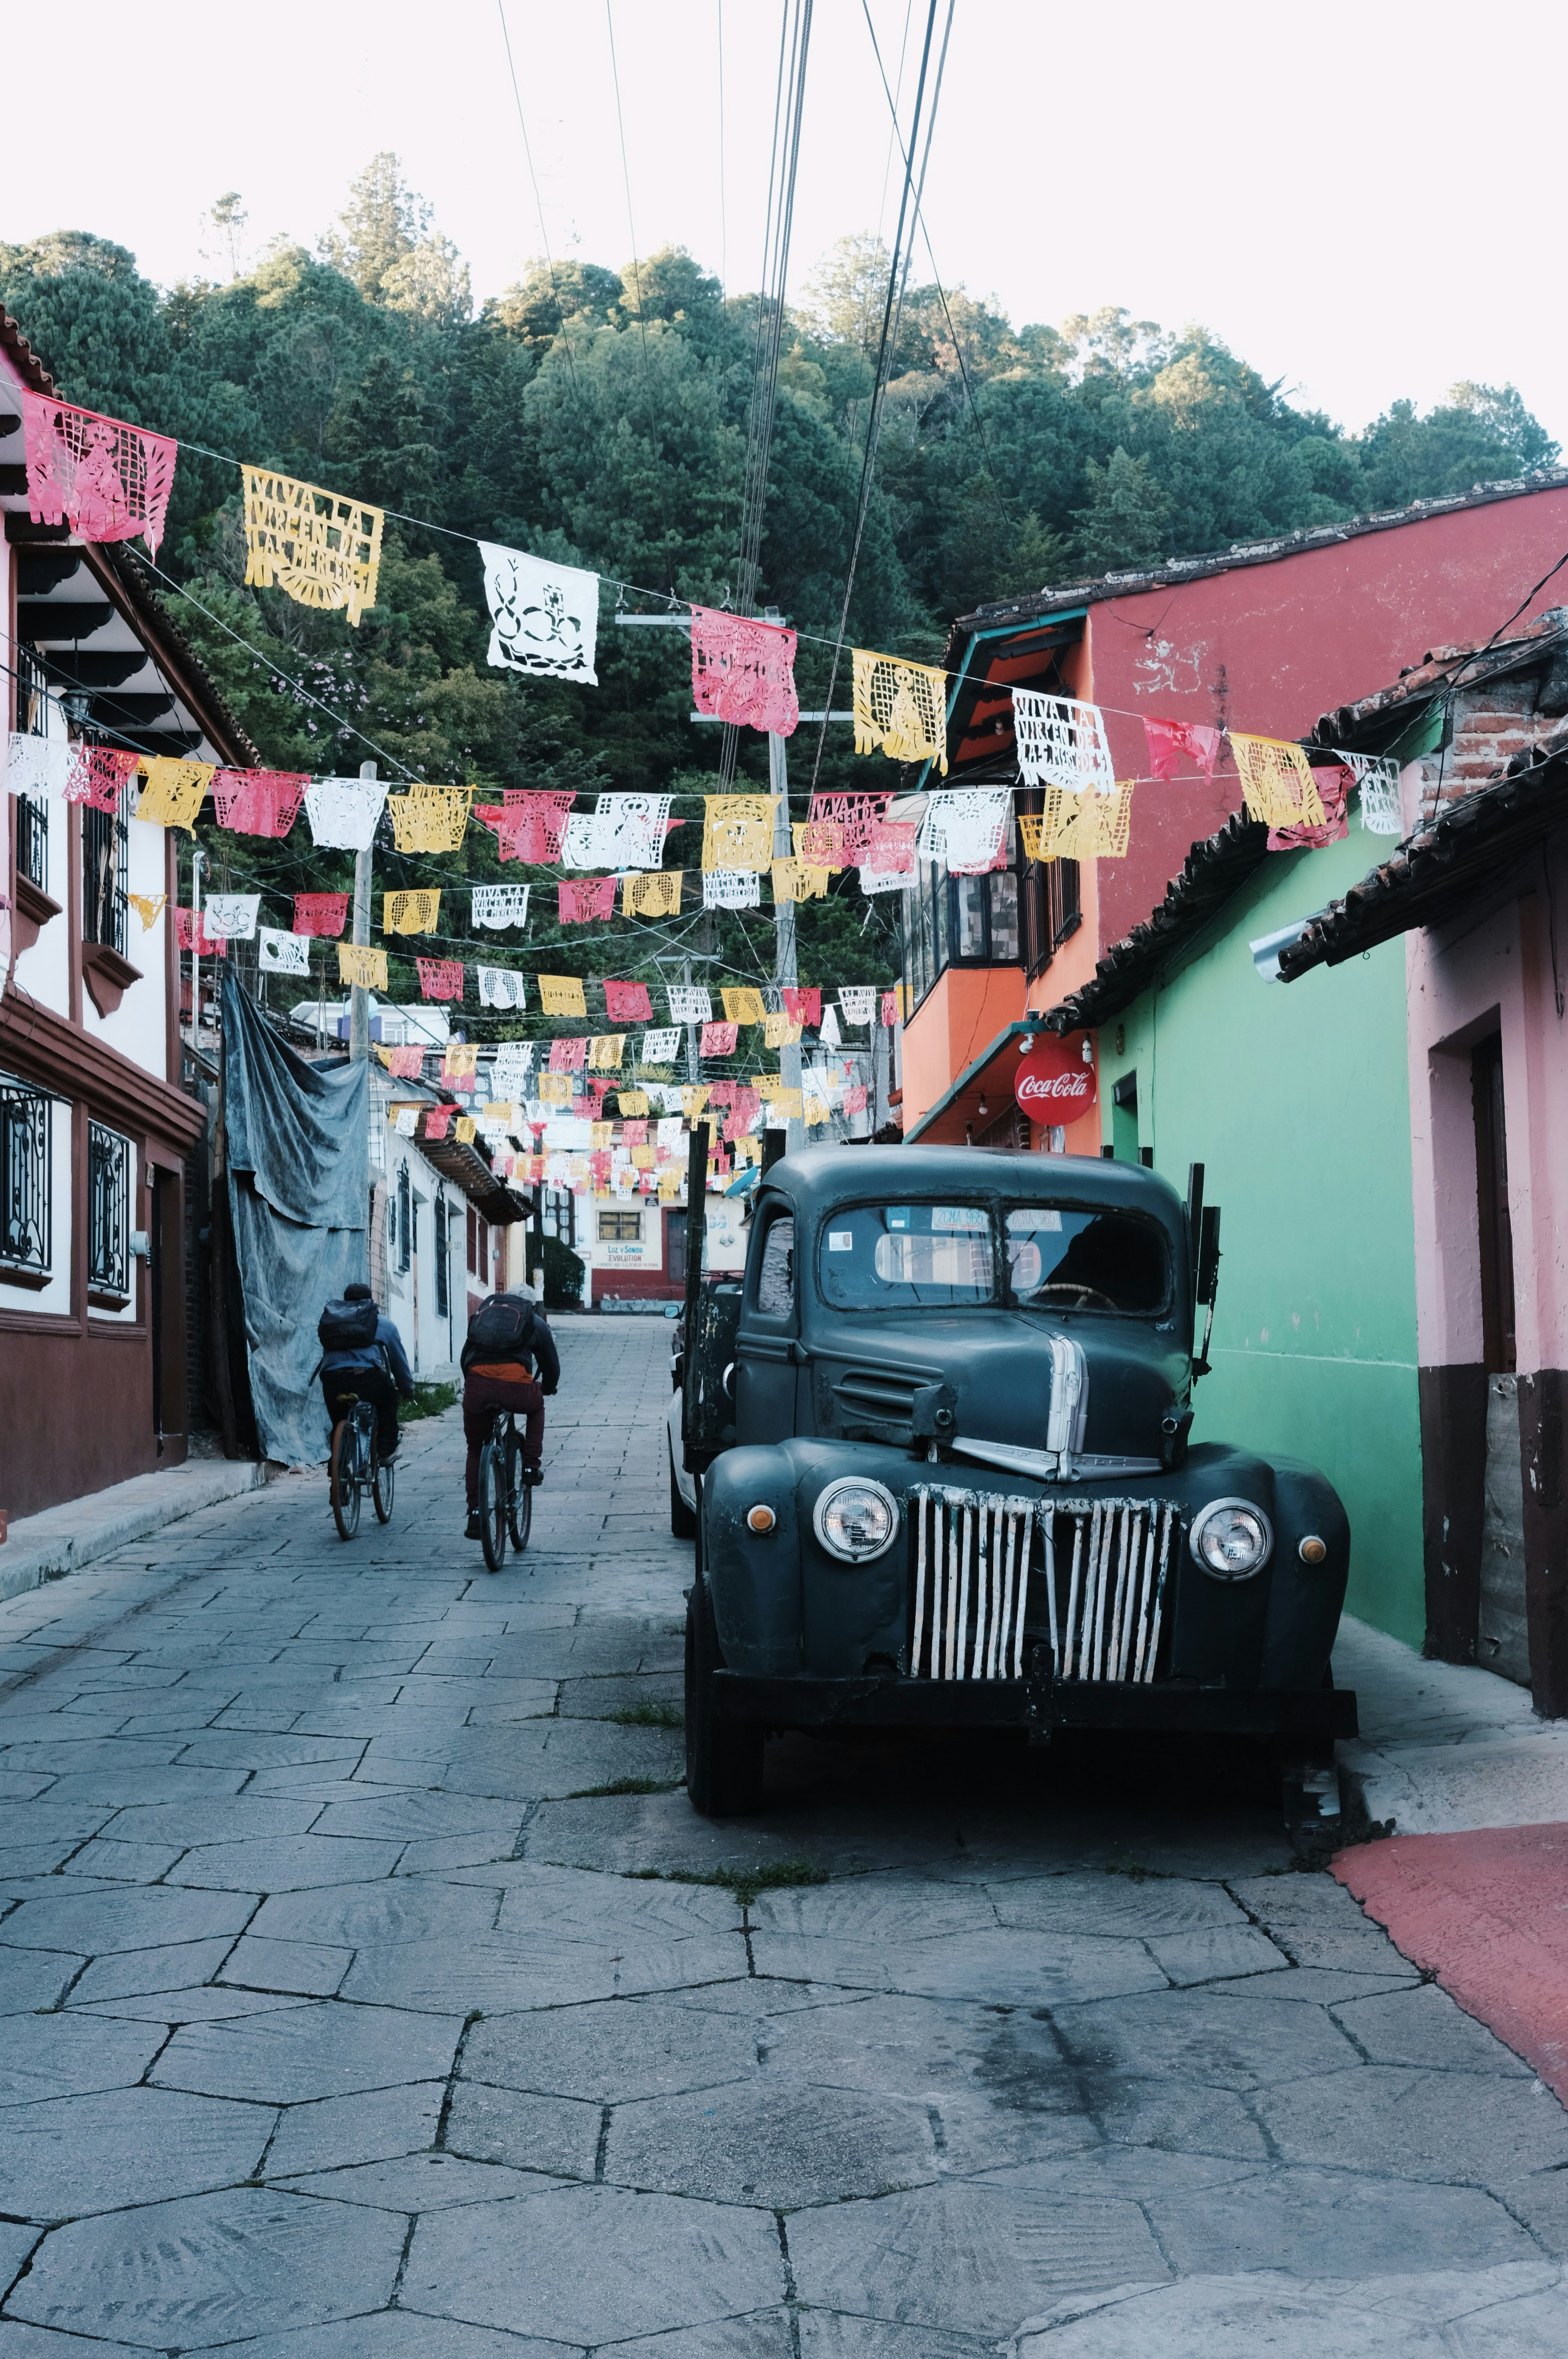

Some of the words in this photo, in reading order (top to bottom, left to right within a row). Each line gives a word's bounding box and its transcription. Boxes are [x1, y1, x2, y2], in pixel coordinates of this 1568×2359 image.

[253, 475, 315, 515] VIVA
[331, 498, 363, 533] LA
[339, 532, 361, 563] DE
[1018, 697, 1060, 721] VIVA
[1067, 705, 1093, 728] LA
[1076, 730, 1095, 750] DE
[817, 797, 849, 821] VIVA
[854, 796, 870, 809] LA
[476, 888, 501, 897] VIVA
[508, 887, 521, 896] LA
[1018, 1072, 1090, 1099] Coca-Cola
[938, 1209, 961, 1224] 2CMA
[966, 1210, 983, 1224] 965
[1012, 1211, 1034, 1225] 2CMA
[1039, 1210, 1055, 1225] 965
